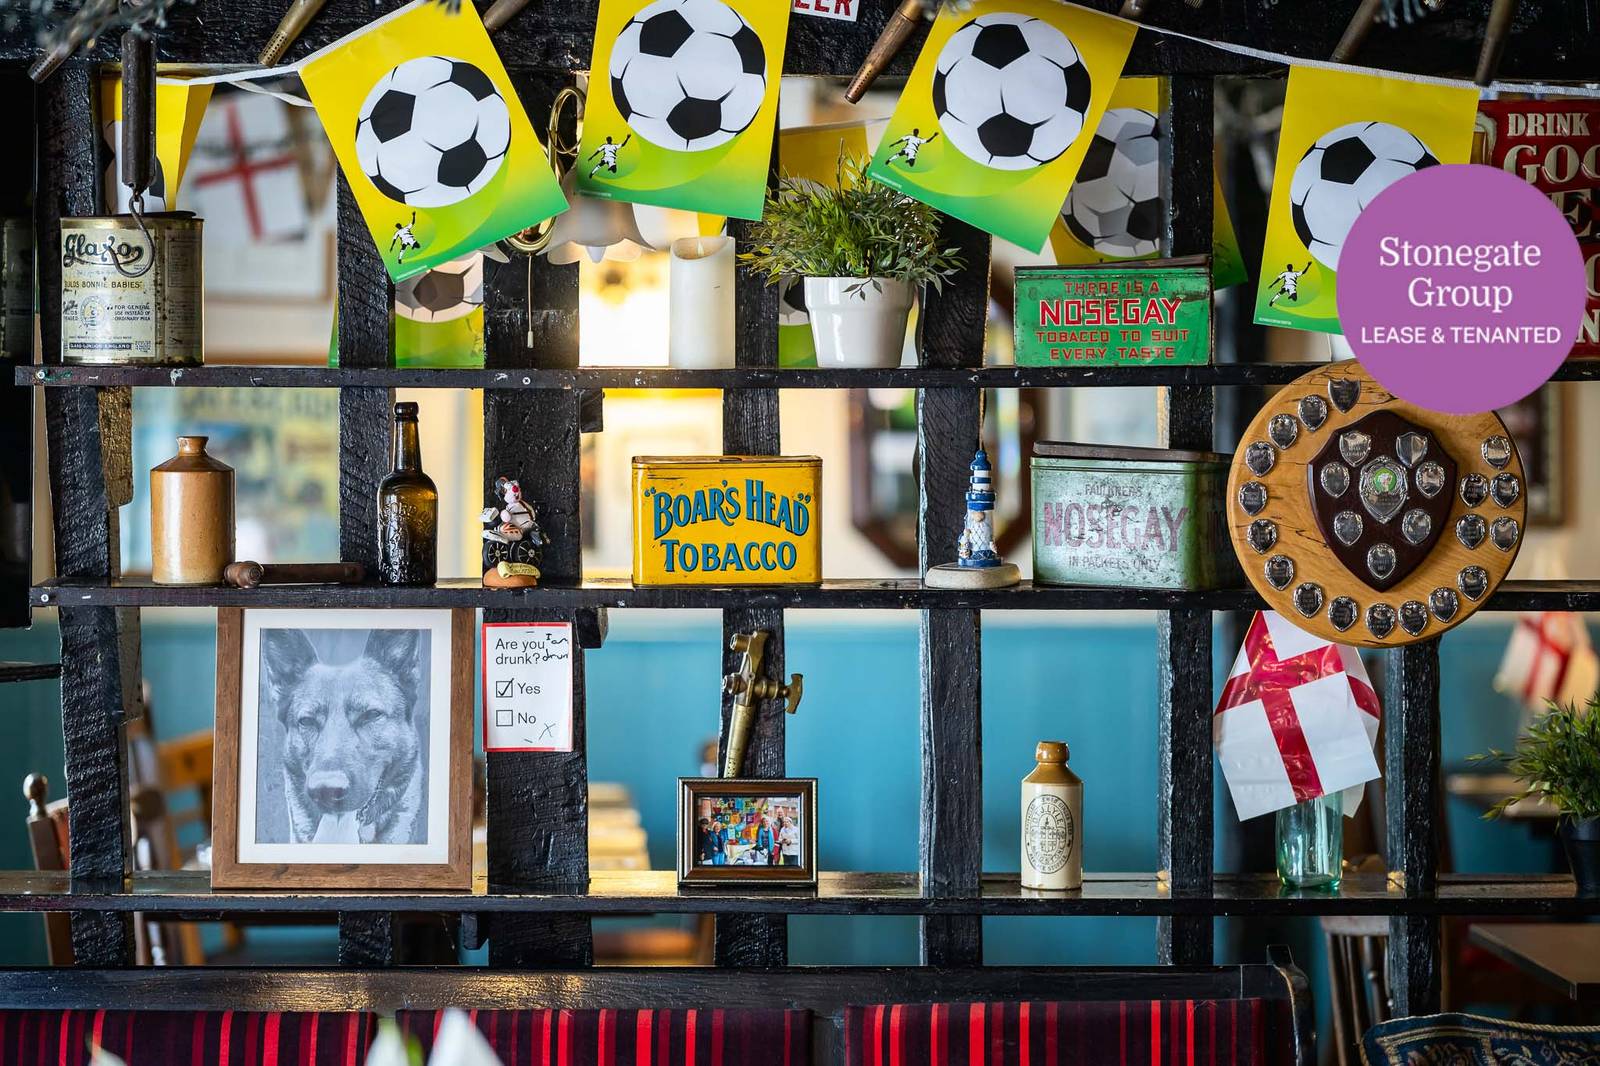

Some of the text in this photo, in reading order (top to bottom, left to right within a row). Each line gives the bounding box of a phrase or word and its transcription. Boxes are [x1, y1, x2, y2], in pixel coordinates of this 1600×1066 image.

[1507, 113, 1590, 137] DRINK
[1064, 281, 1160, 294] THERE IS A
[1039, 297, 1183, 327] NOSEGAY
[1035, 329, 1189, 343] TOBACCO TO SUIT
[1051, 347, 1176, 360] EVERY TASTE
[1043, 502, 1189, 551] NOSEGAY
[660, 539, 797, 573] TOBACCO
[1068, 556, 1079, 567] IN
[495, 638, 545, 653] Are you
[495, 653, 541, 665] drunk?
[518, 682, 541, 695] Yes
[518, 712, 537, 724] No
